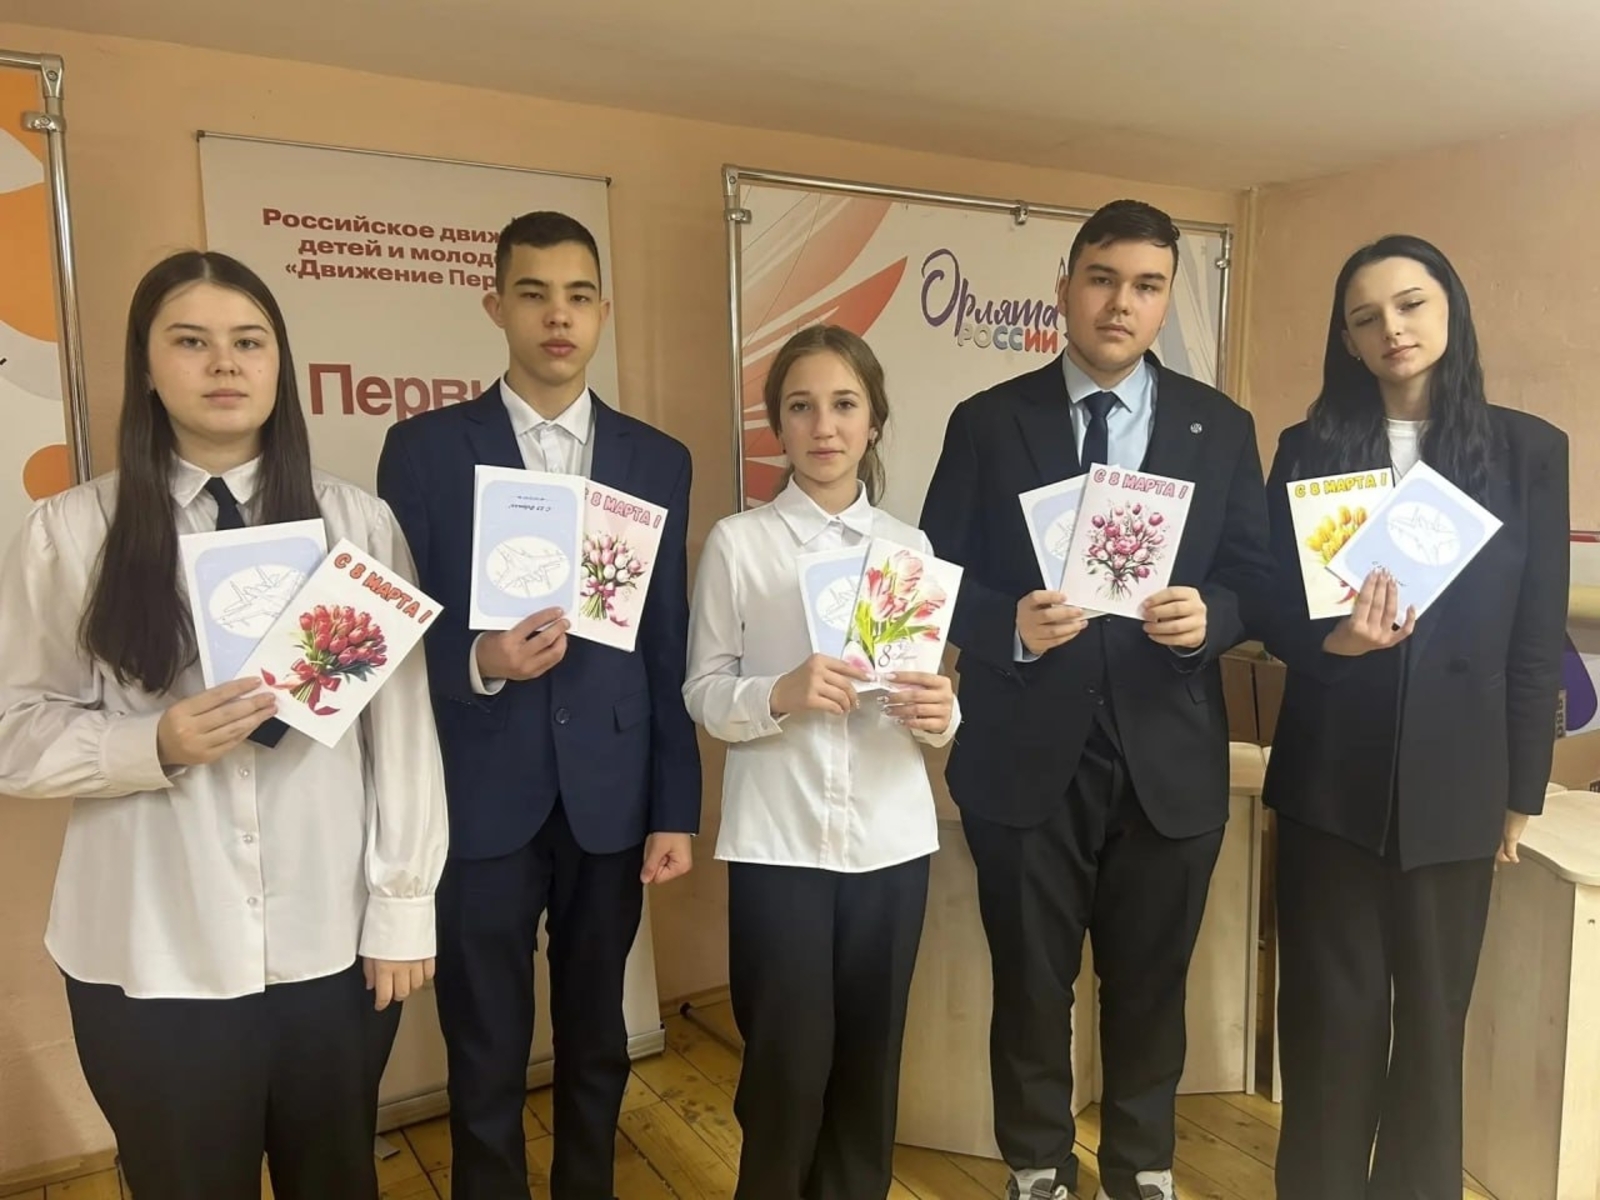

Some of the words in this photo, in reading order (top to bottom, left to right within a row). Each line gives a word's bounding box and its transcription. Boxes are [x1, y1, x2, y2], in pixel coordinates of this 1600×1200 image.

[262, 208, 435, 239] Российское
[298, 239, 382, 258] детей
[388, 244, 405, 259] и
[410, 249, 497, 268] молод
[285, 259, 444, 285] «Движение
[450, 269, 496, 291] Пер
[921, 248, 1059, 337] Орлята
[957, 323, 1058, 354] РОССИИ
[309, 363, 484, 421] Перв
[1093, 468, 1106, 484] С
[1108, 472, 1120, 486] 8
[1121, 473, 1176, 498] МАРТА
[1295, 484, 1306, 498] С
[1310, 482, 1320, 496] 8
[1323, 474, 1377, 494] МАРТА
[591, 491, 602, 507] 8
[603, 495, 651, 526] МАРТА
[333, 553, 352, 570] С
[349, 563, 367, 580] 8
[362, 571, 421, 619] МАРТА
[878, 644, 892, 668] 8
